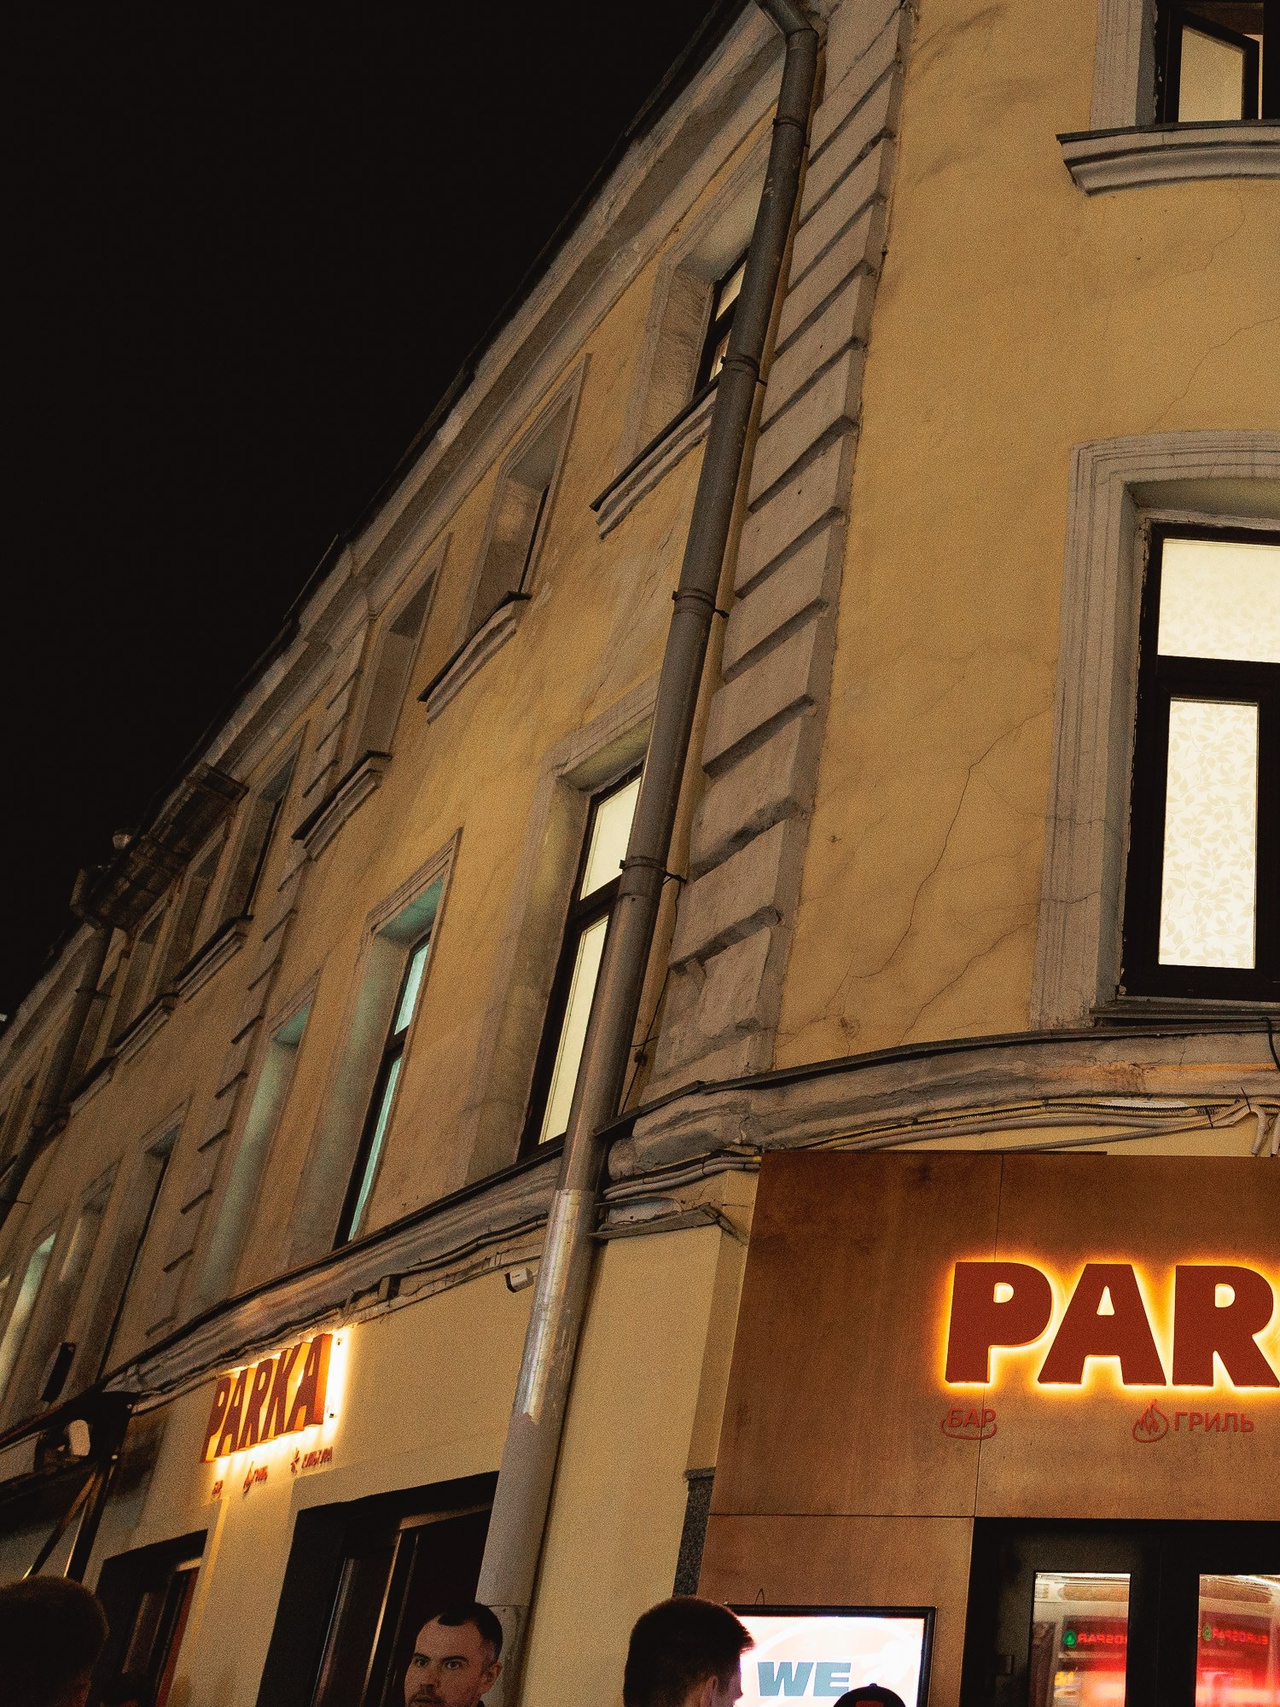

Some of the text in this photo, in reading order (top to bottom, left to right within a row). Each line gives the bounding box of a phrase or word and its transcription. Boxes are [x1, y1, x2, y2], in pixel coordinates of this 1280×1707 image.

[201, 1333, 333, 1463] PARKA
[947, 1407, 997, 1429] БАР
[1173, 1411, 1255, 1433] ГРИЛЬ
[757, 1661, 852, 1698] WE
